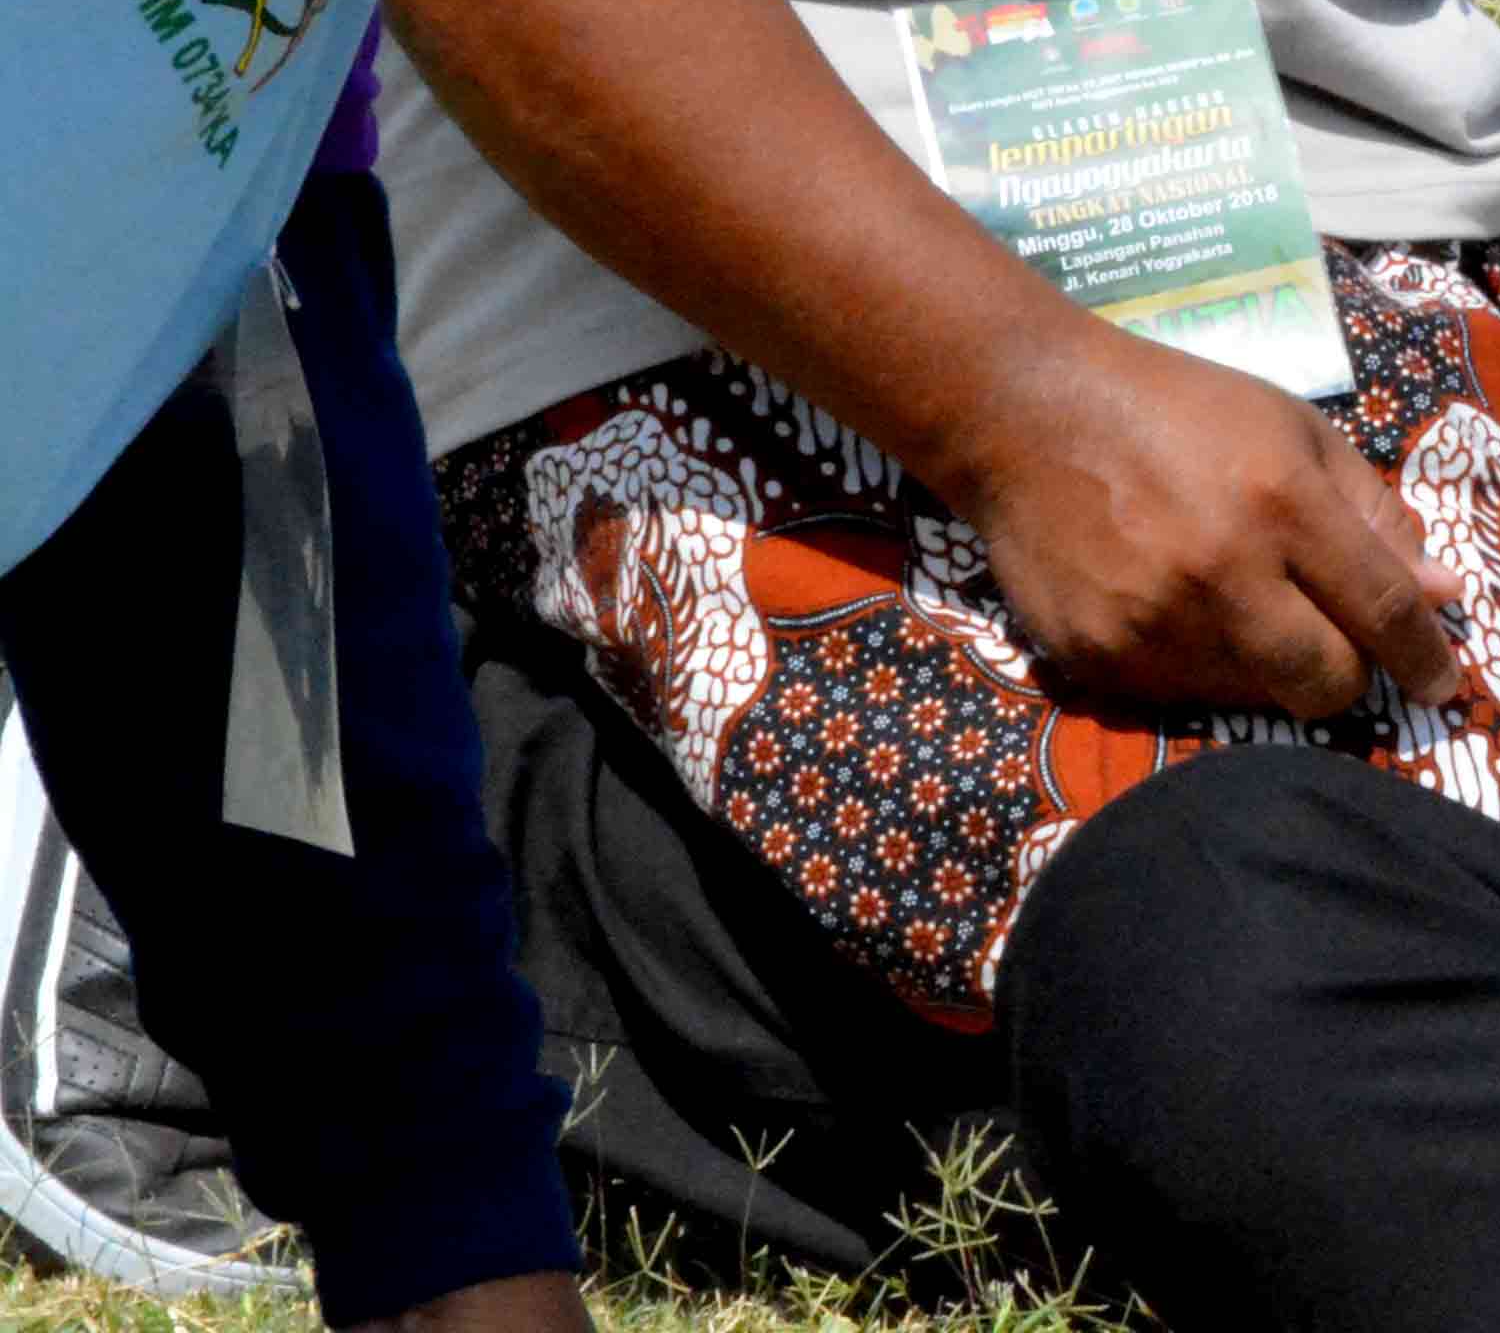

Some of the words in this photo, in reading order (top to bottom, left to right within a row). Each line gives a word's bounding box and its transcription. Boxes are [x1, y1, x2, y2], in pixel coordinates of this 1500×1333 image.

[1016, 225, 1105, 258] Minggu,
[1138, 198, 1224, 229] Oktober
[1229, 184, 1281, 211] 2018
[1060, 240, 1147, 272] Lapangan
[1086, 264, 1140, 287] Kenari
[1144, 242, 1234, 274] Yogyakarta
